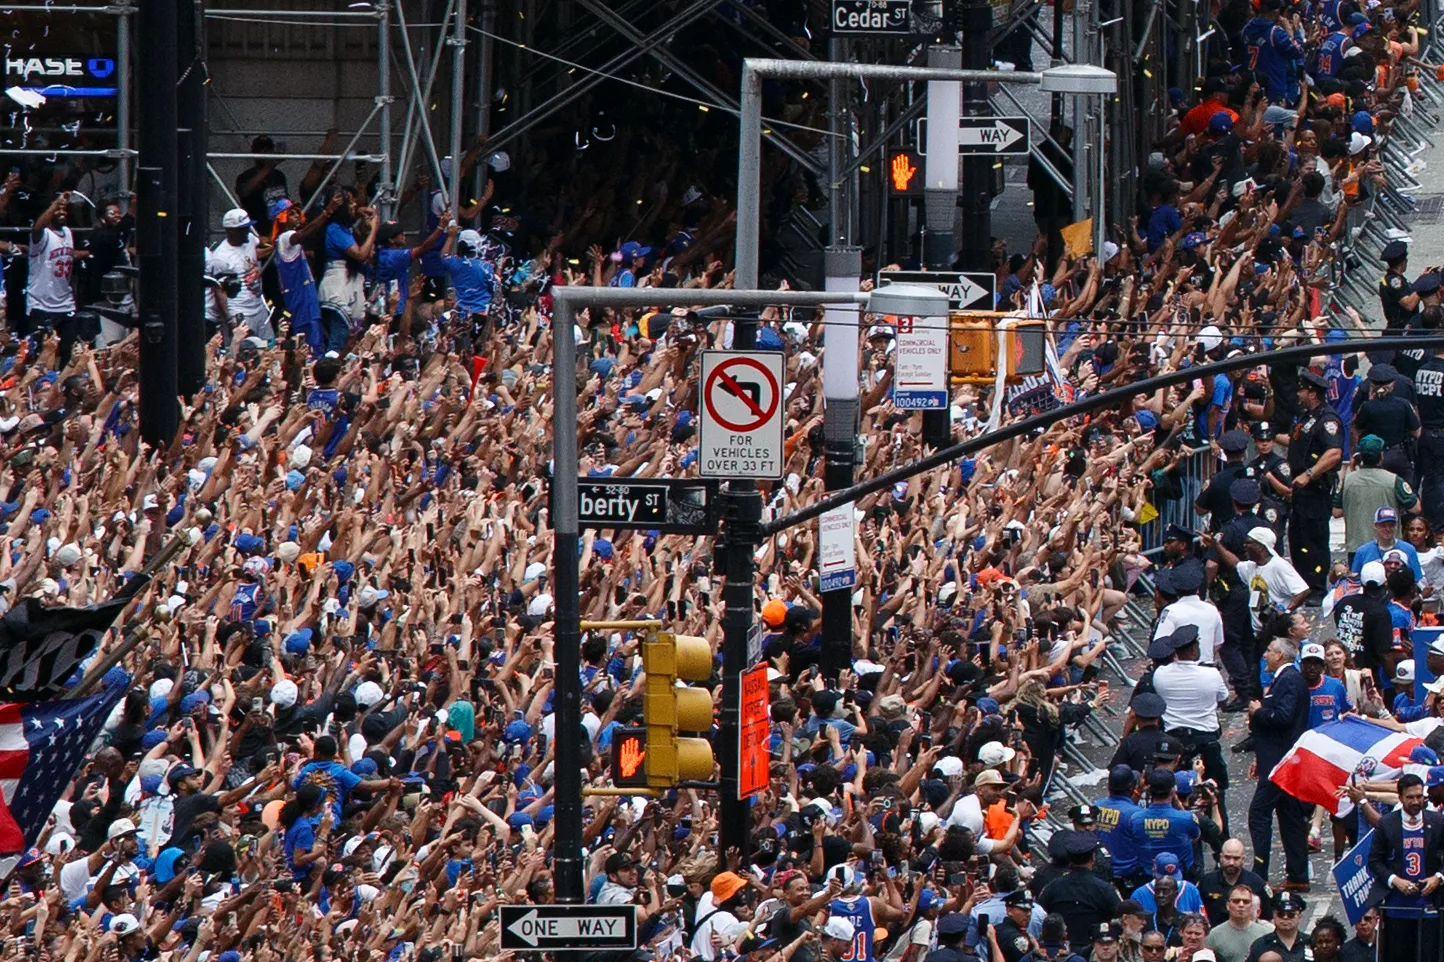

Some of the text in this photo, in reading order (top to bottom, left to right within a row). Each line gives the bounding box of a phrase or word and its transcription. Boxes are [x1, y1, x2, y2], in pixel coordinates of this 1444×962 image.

[835, 6, 907, 27] Cedar ST
[980, 128, 1010, 144] WAY
[939, 283, 972, 301] WAY
[1416, 369, 1443, 384] NYPD
[729, 436, 753, 446] FOR
[712, 448, 770, 459] VEHICLES
[707, 460, 775, 471] OVER 33 FT
[580, 492, 660, 521] berty ST
[1144, 818, 1169, 830] NYPD
[1405, 852, 1421, 876] 3
[1340, 865, 1370, 898] THANK
[521, 917, 618, 936] ONE WAY
